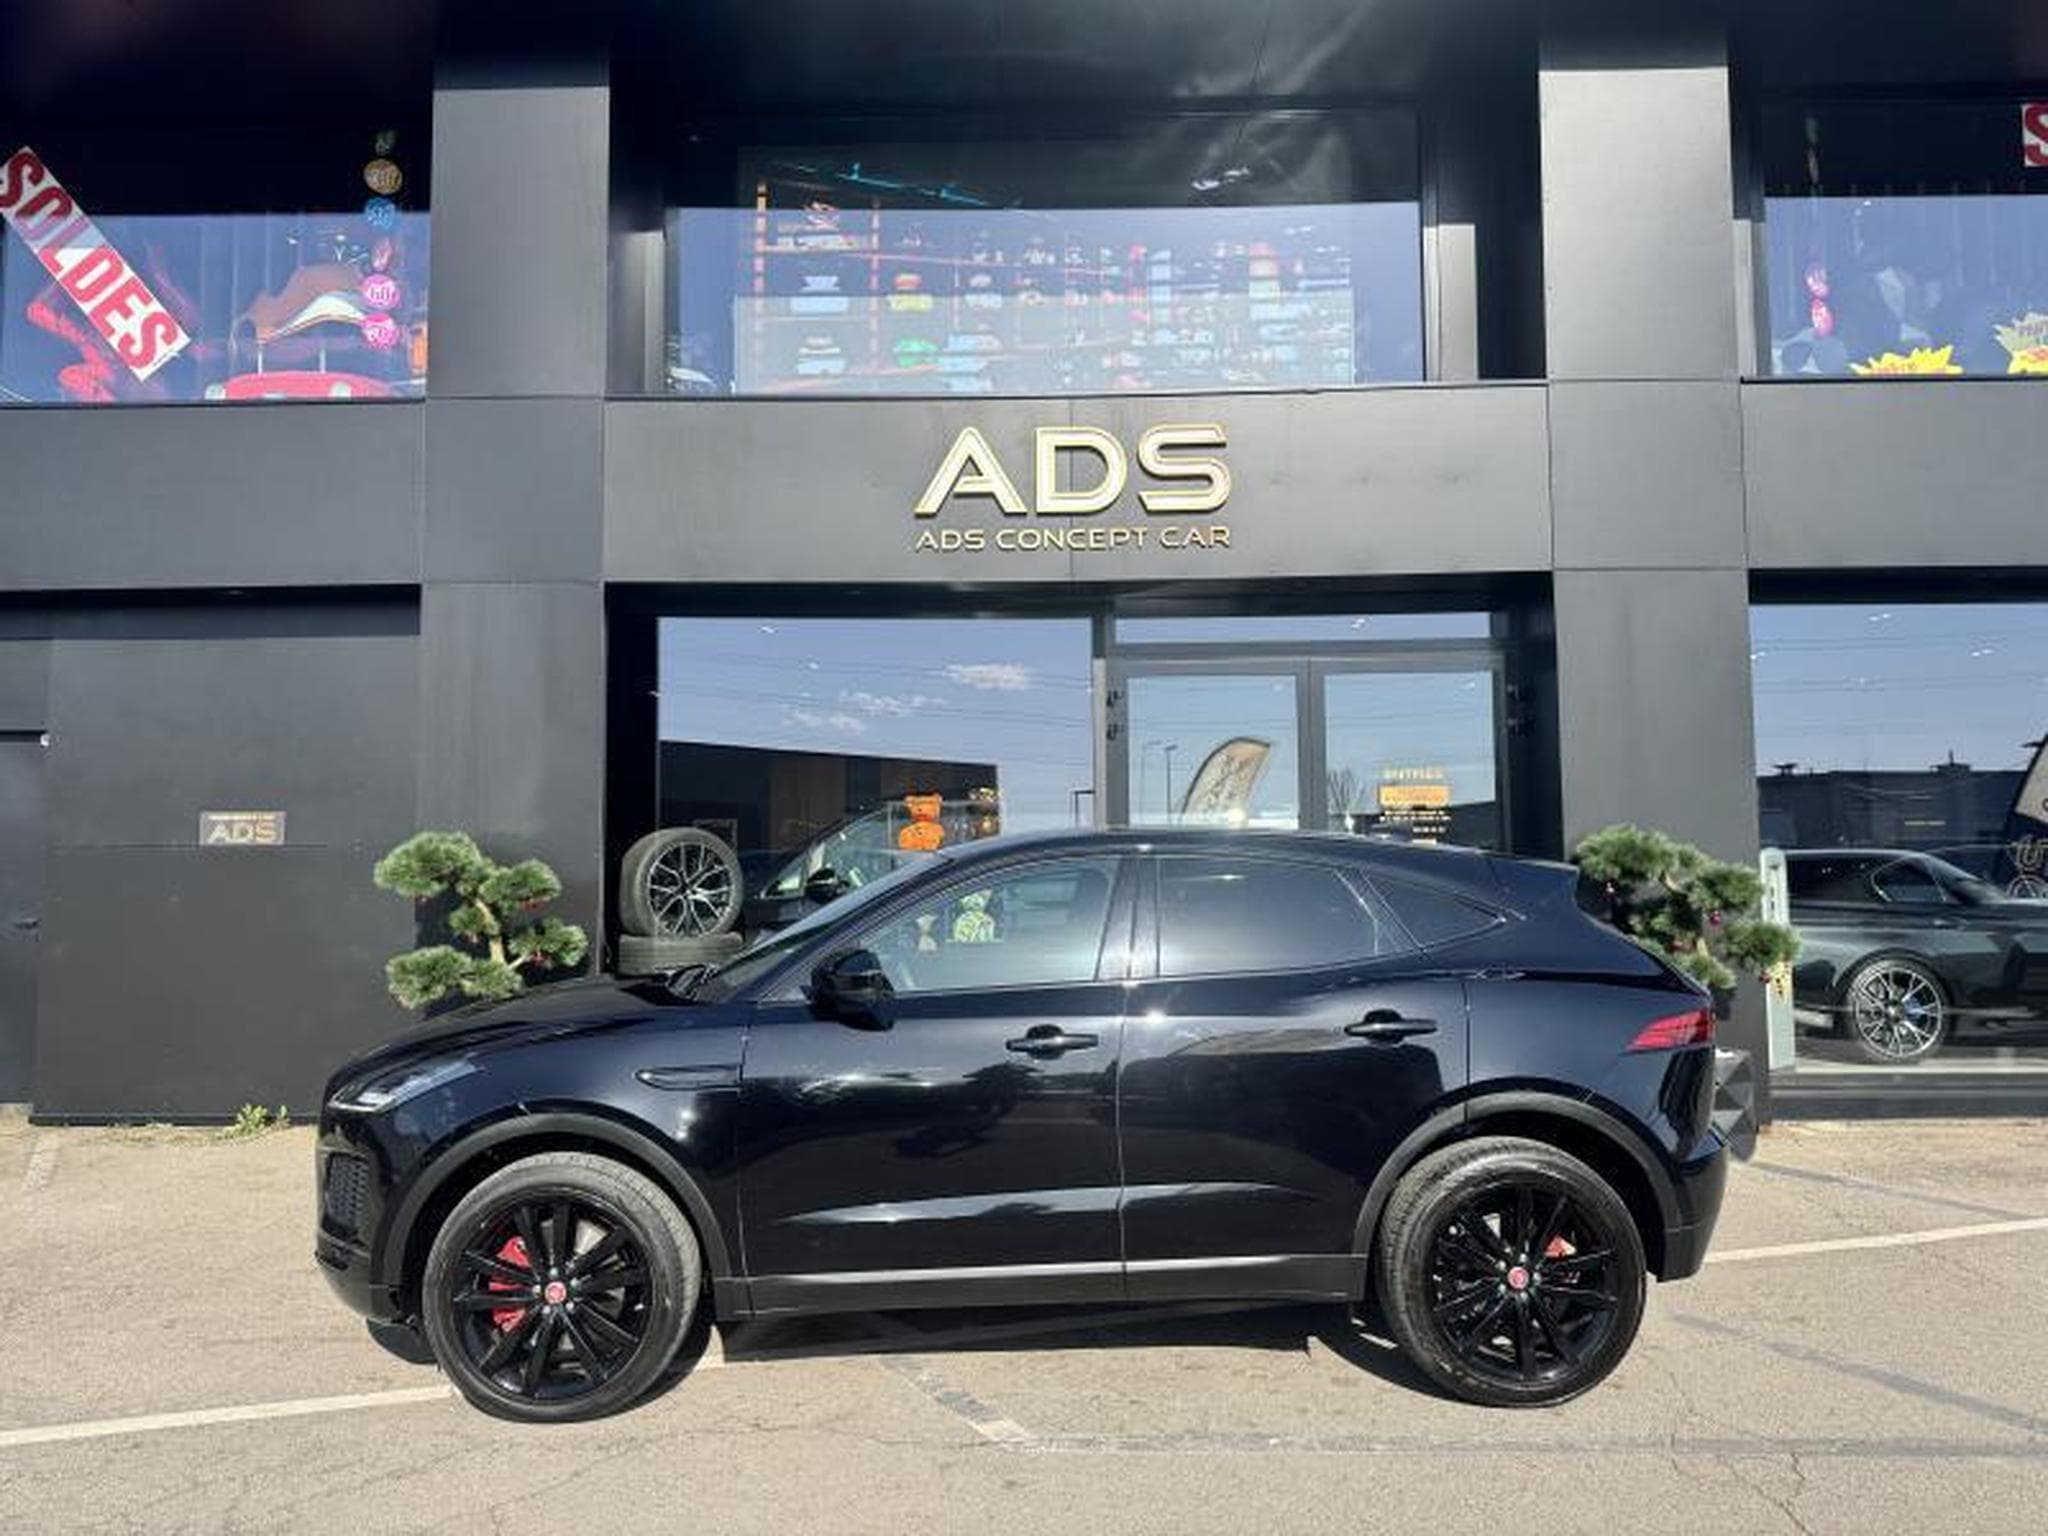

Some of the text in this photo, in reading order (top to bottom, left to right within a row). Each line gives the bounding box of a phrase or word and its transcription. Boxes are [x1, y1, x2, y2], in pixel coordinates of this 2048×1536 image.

[0, 152, 178, 370] SOLDES
[914, 424, 1232, 517] ADS
[915, 525, 1232, 551] ADS CONCEPT CAR
[206, 821, 278, 845] ADS
